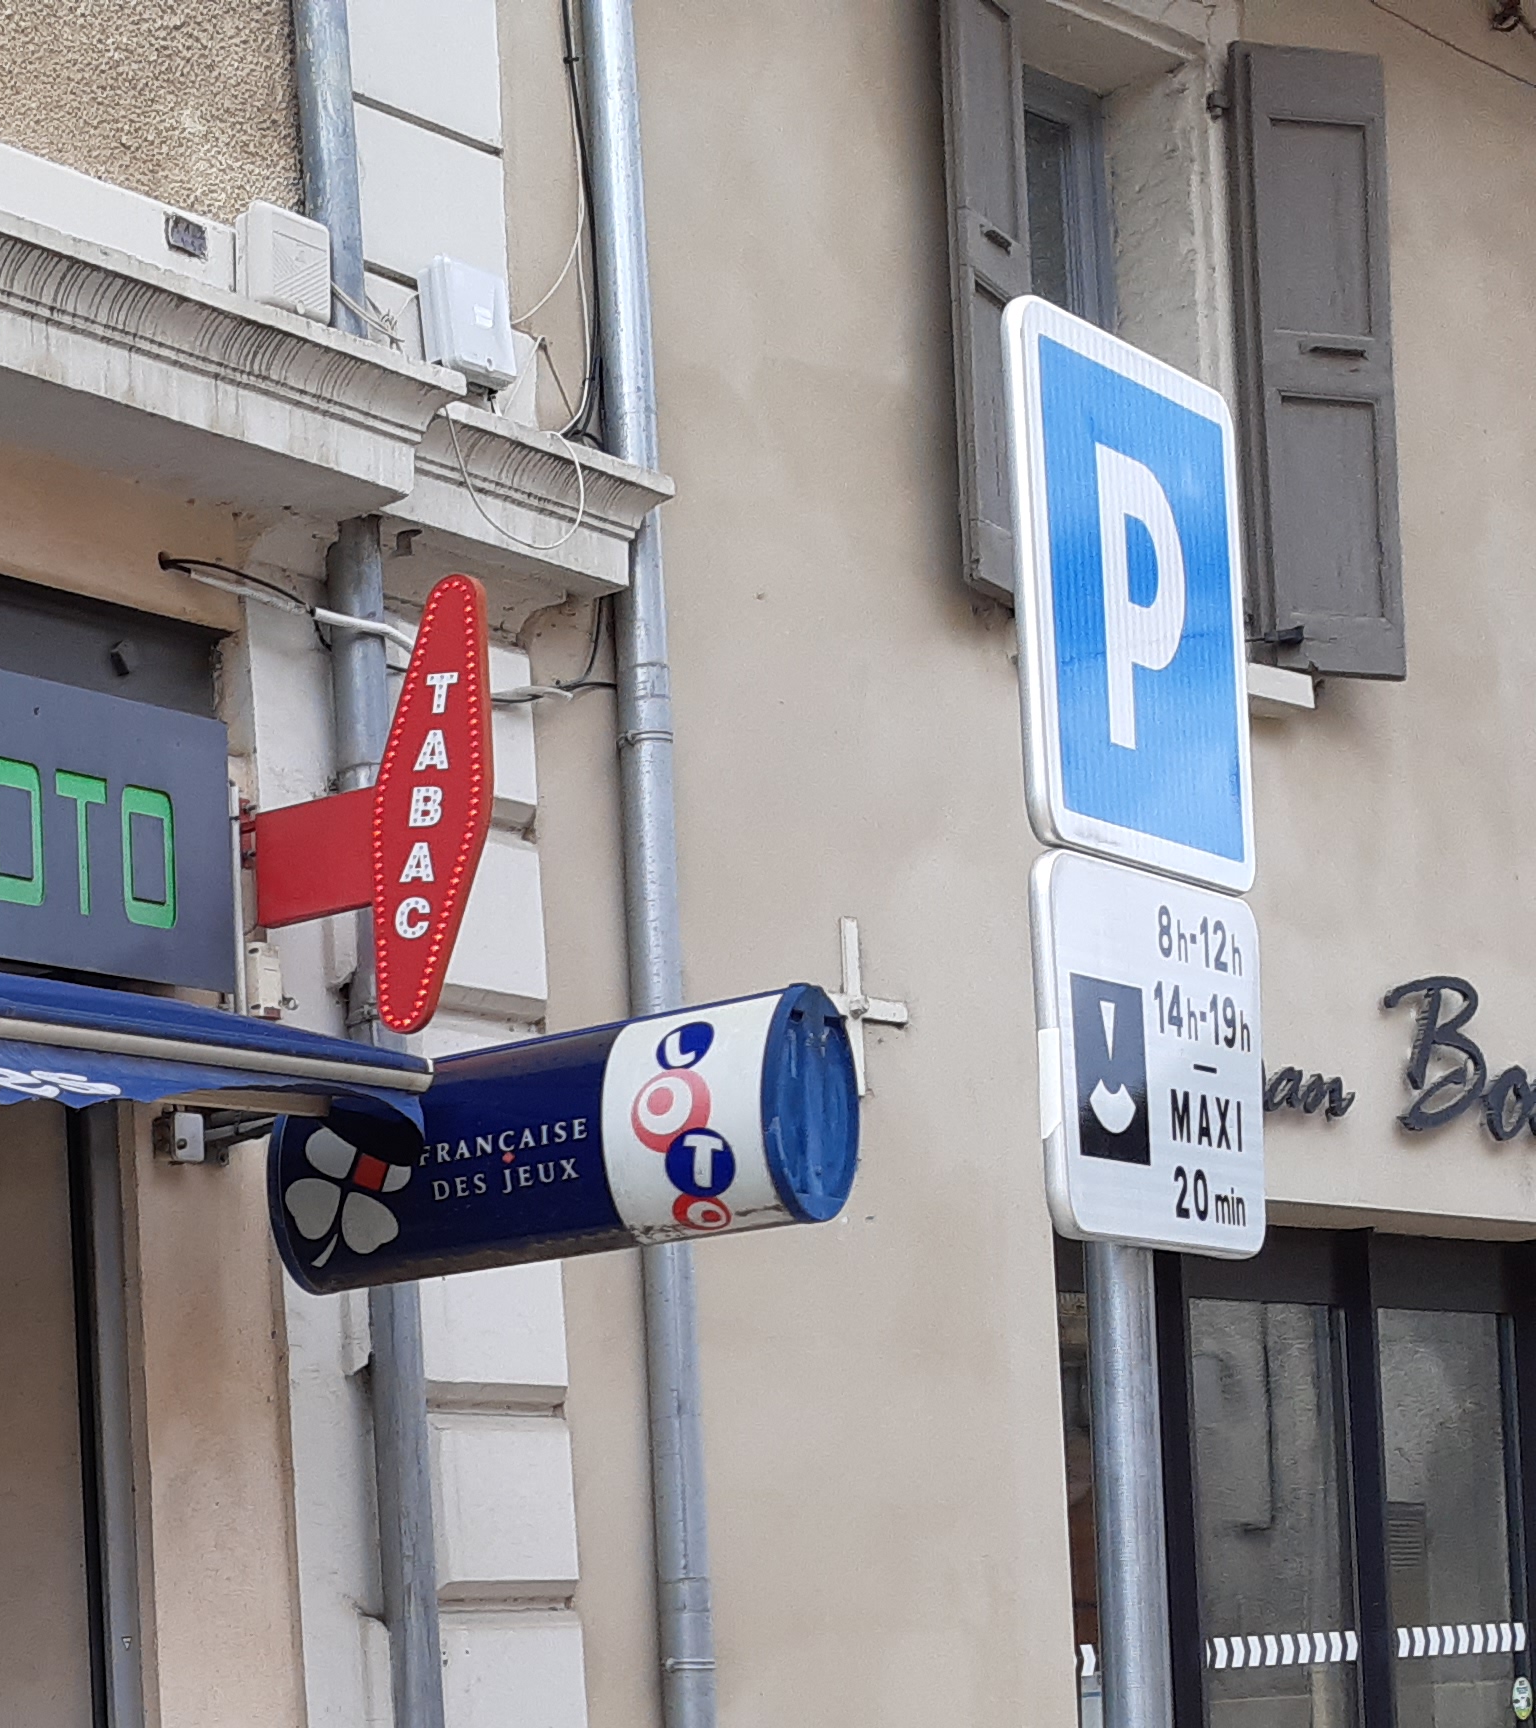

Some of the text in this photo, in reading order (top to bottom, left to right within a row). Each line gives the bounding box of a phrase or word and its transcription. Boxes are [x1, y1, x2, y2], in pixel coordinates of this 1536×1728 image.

[1094, 441, 1185, 749] P
[394, 671, 458, 940] TABAC
[1157, 905, 1243, 976] 8h-12h
[1154, 981, 1250, 1052] 14h-19h
[1382, 976, 1536, 1141] Bo
[1171, 1088, 1243, 1152] MAXI
[432, 1158, 580, 1201] DES JEUX
[1174, 1165, 1246, 1227] 20 min
